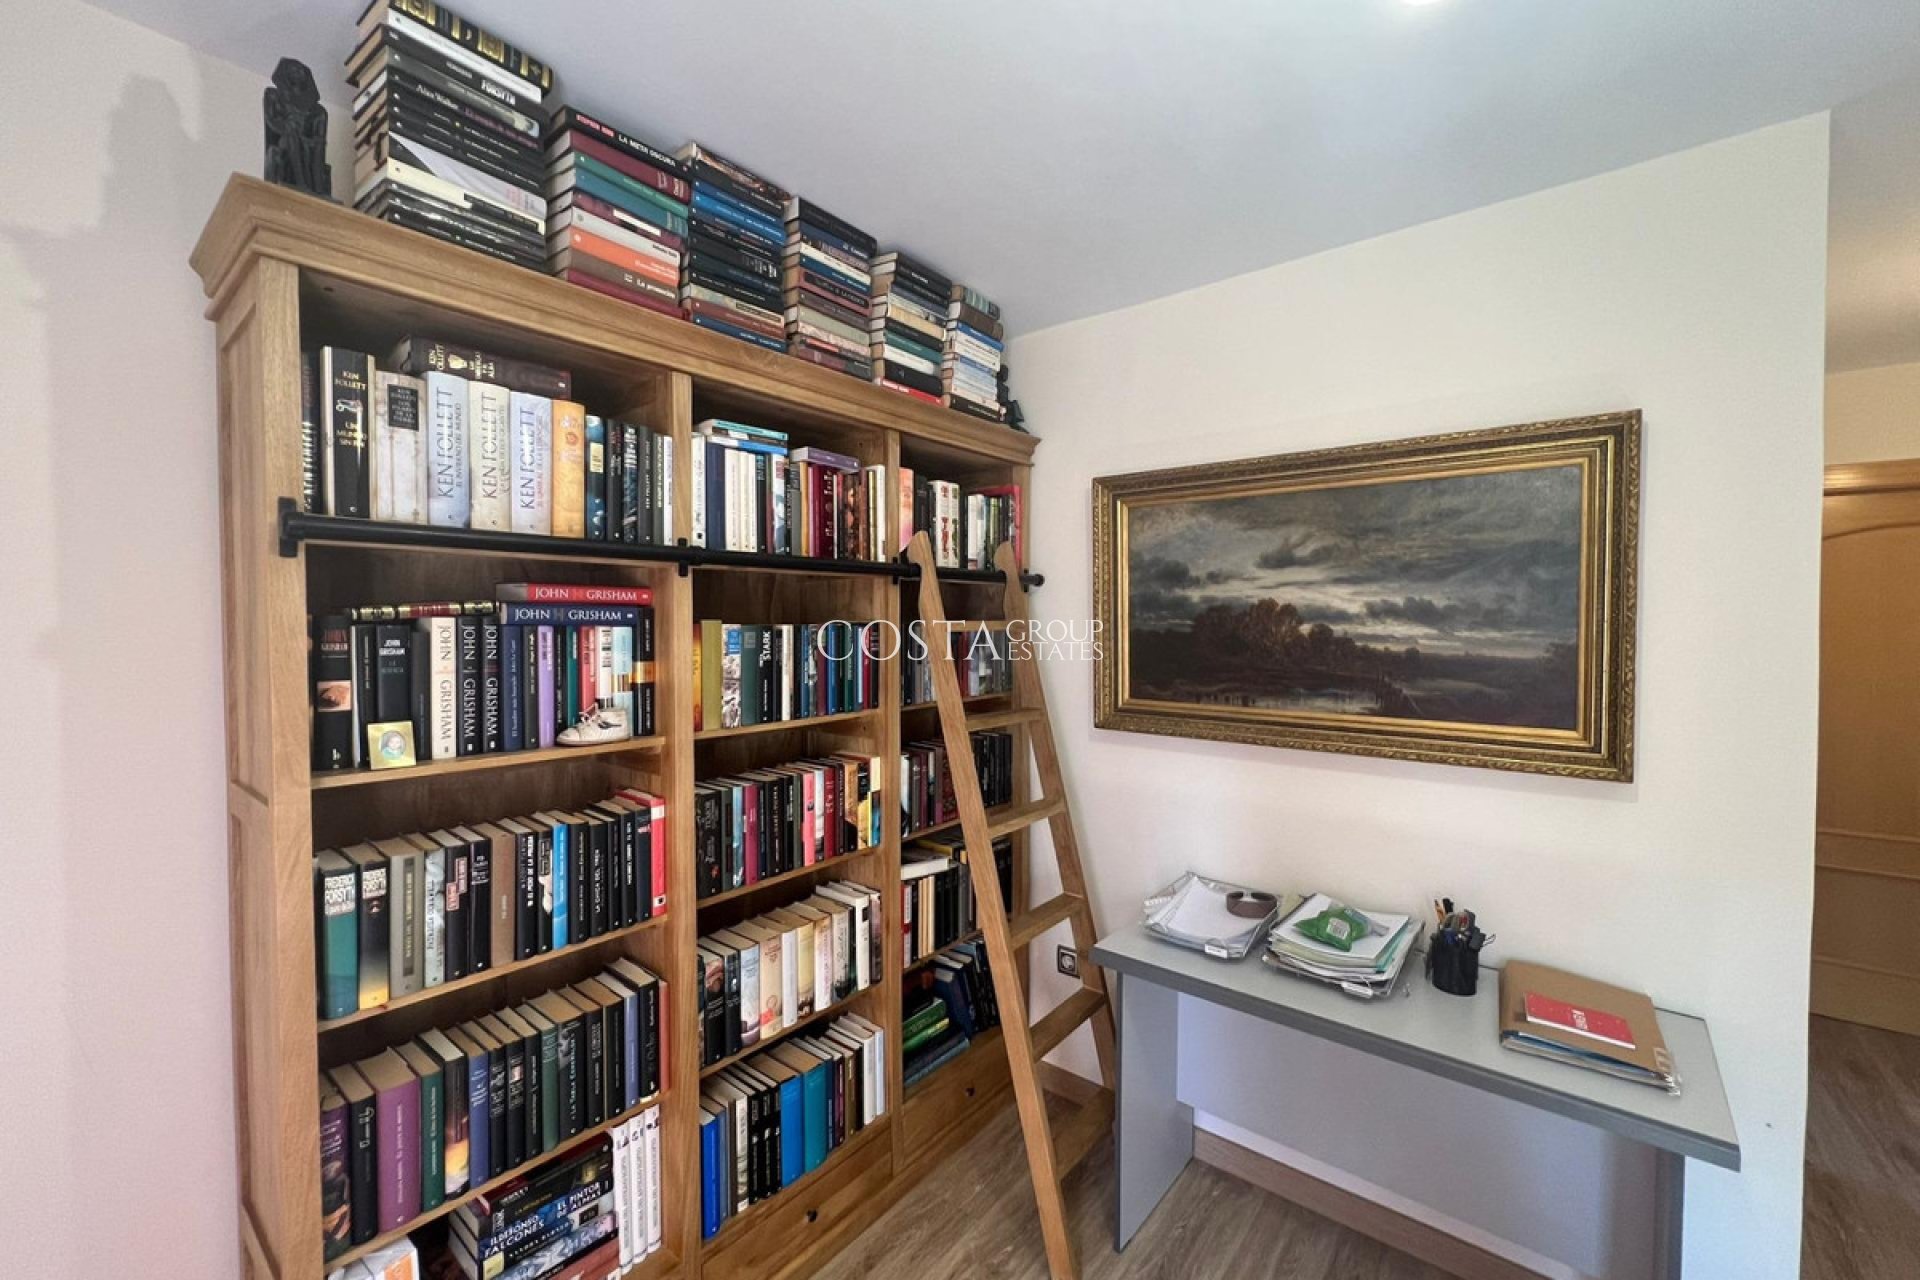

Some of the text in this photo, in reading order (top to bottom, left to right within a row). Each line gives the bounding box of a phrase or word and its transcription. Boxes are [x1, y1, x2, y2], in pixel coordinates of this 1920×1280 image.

[618, 133, 628, 144] LA
[342, 370, 359, 380] KEN
[436, 386, 454, 499] KEN FOLLETT
[482, 392, 497, 499] KEN FOLLETT
[520, 407, 535, 510] KEN FOLLETT
[535, 586, 637, 601] JOHN GRISHAM
[515, 609, 622, 621] JOHN GRISHAM
[437, 625, 451, 740] JOHN GRISHAM
[463, 625, 476, 738] JOHN GRISHAM
[485, 624, 498, 737] JOHN GRISHAM
[594, 904, 601, 913] LA
[569, 1104, 576, 1114] LA
[569, 1181, 600, 1204] PINTOR
[572, 1190, 602, 1212] ALMAS
[483, 1219, 545, 1258] FALCONES
[489, 1214, 539, 1246] ILDEFONSO
